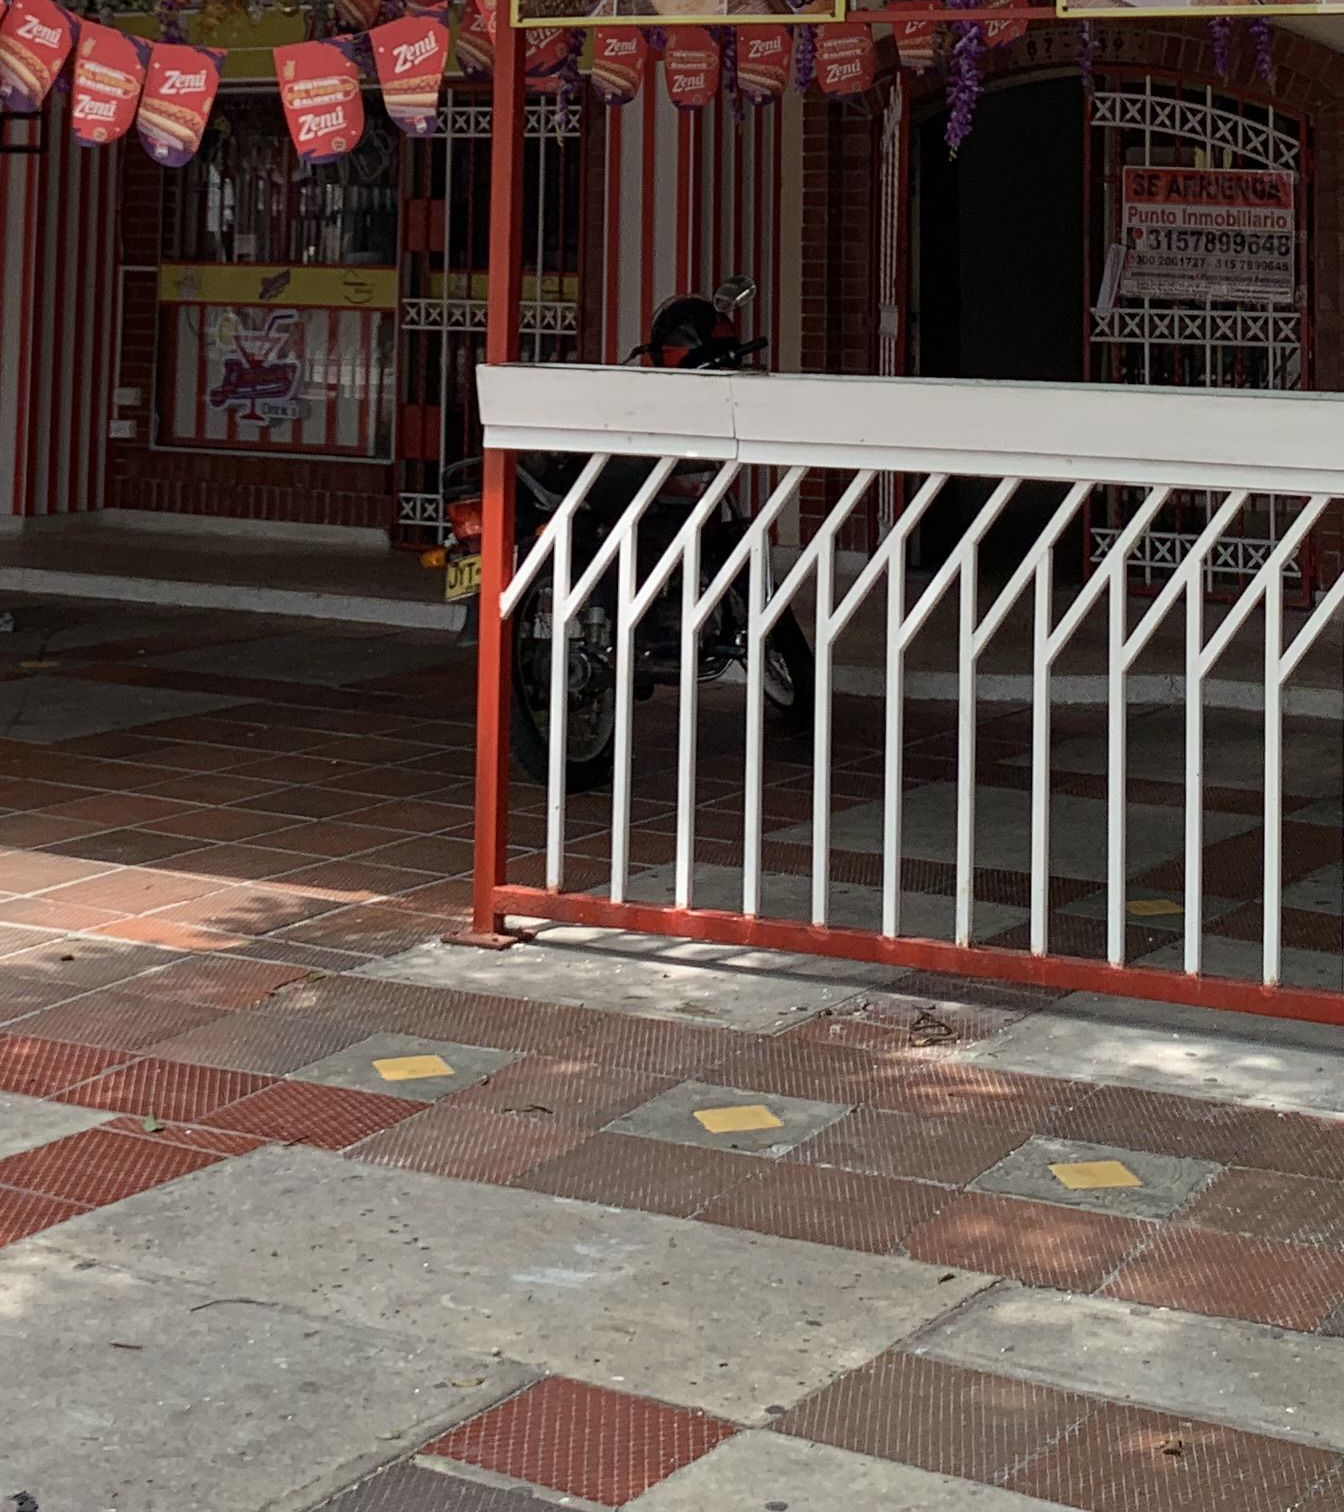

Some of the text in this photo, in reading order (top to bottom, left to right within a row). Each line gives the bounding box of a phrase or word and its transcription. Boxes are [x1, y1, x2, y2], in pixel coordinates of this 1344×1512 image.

[16, 14, 63, 49] Zenú
[392, 30, 440, 74] Zenú
[604, 37, 638, 57] Zenú
[748, 35, 783, 60] Zenú
[160, 69, 208, 95] Zenú
[672, 72, 706, 94] Zenú
[826, 59, 864, 85] Zenú
[73, 93, 118, 121] Zenú
[297, 106, 347, 142] Zenú
[1132, 172, 1161, 198] SE
[1127, 205, 1288, 229] Punto Inmobiliario
